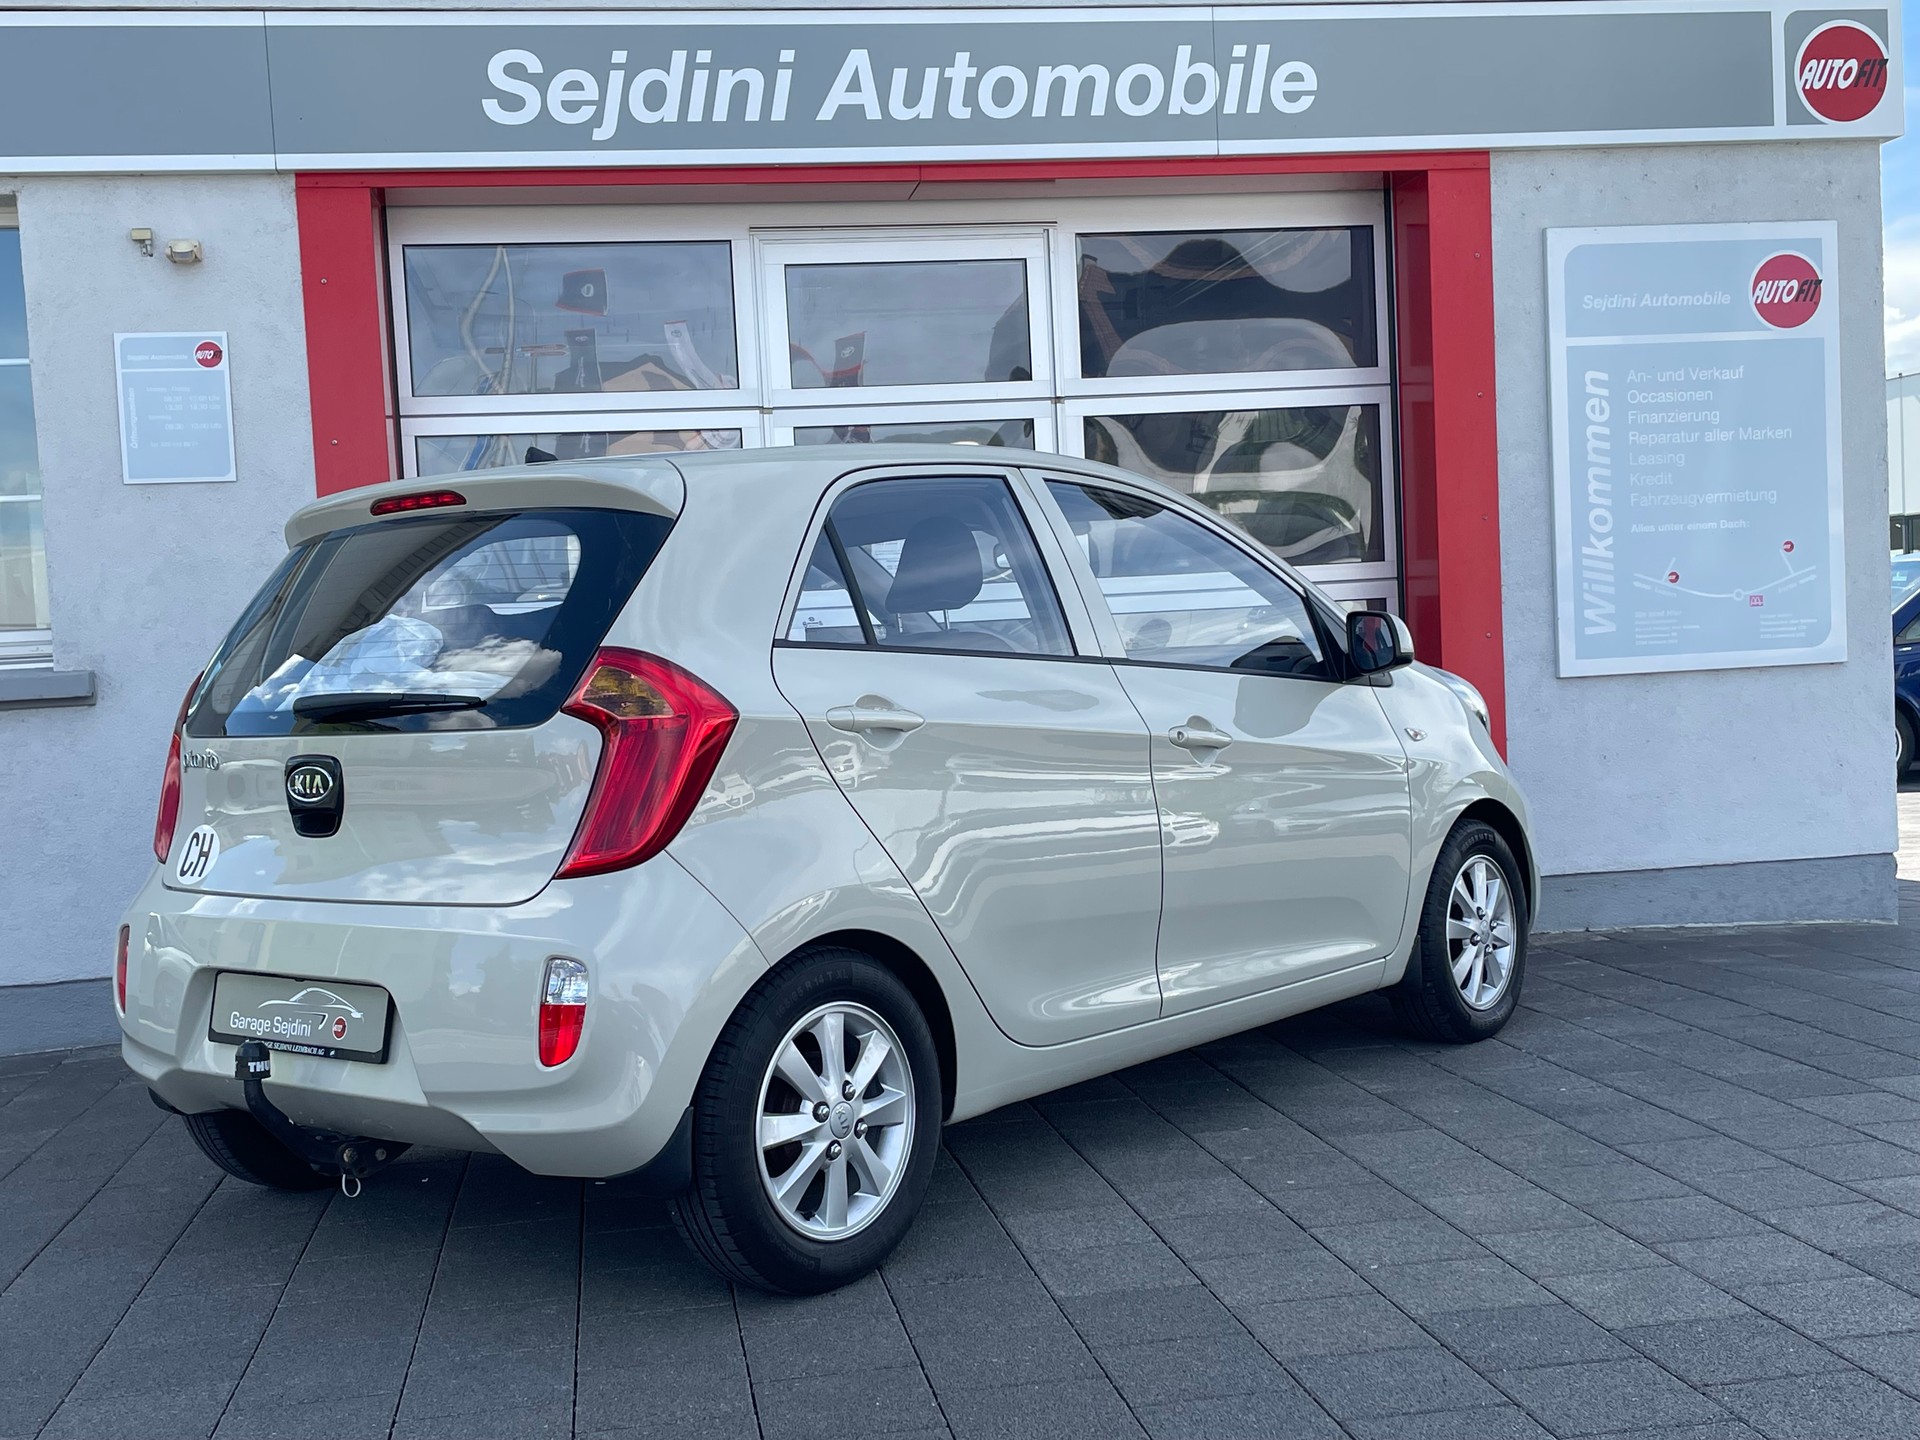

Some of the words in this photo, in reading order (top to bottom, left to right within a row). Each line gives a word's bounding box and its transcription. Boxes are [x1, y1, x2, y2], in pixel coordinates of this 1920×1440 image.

[1800, 58, 1889, 90] AUTOFIT
[481, 49, 796, 141] Sejdini
[816, 44, 1319, 122] Automobile
[1582, 293, 1637, 312] Sejdini
[1640, 291, 1731, 308] Automobile
[1752, 279, 1823, 304] AUTOFIT
[1627, 368, 1652, 383] An-
[1657, 367, 1685, 383] und
[1688, 365, 1745, 381] Verkauf
[1627, 389, 1713, 404] Occasionen
[1628, 408, 1720, 425] Finanzierung
[1629, 430, 1700, 446] Reparatur
[1704, 428, 1735, 442] aller
[1739, 426, 1793, 441] Marken
[1629, 452, 1686, 467] Leasing
[1630, 472, 1673, 486] Kredit
[1582, 369, 1617, 635] Willkommen
[1630, 488, 1778, 507] Fahrzeugvermietung
[1631, 523, 1656, 534] Alles
[1658, 521, 1684, 532] unter
[1720, 518, 1750, 530] Dach:
[294, 774, 325, 794] KIA
[179, 832, 215, 878] CH
[230, 1011, 271, 1036] Garage
[273, 1016, 312, 1039] Sejdini
